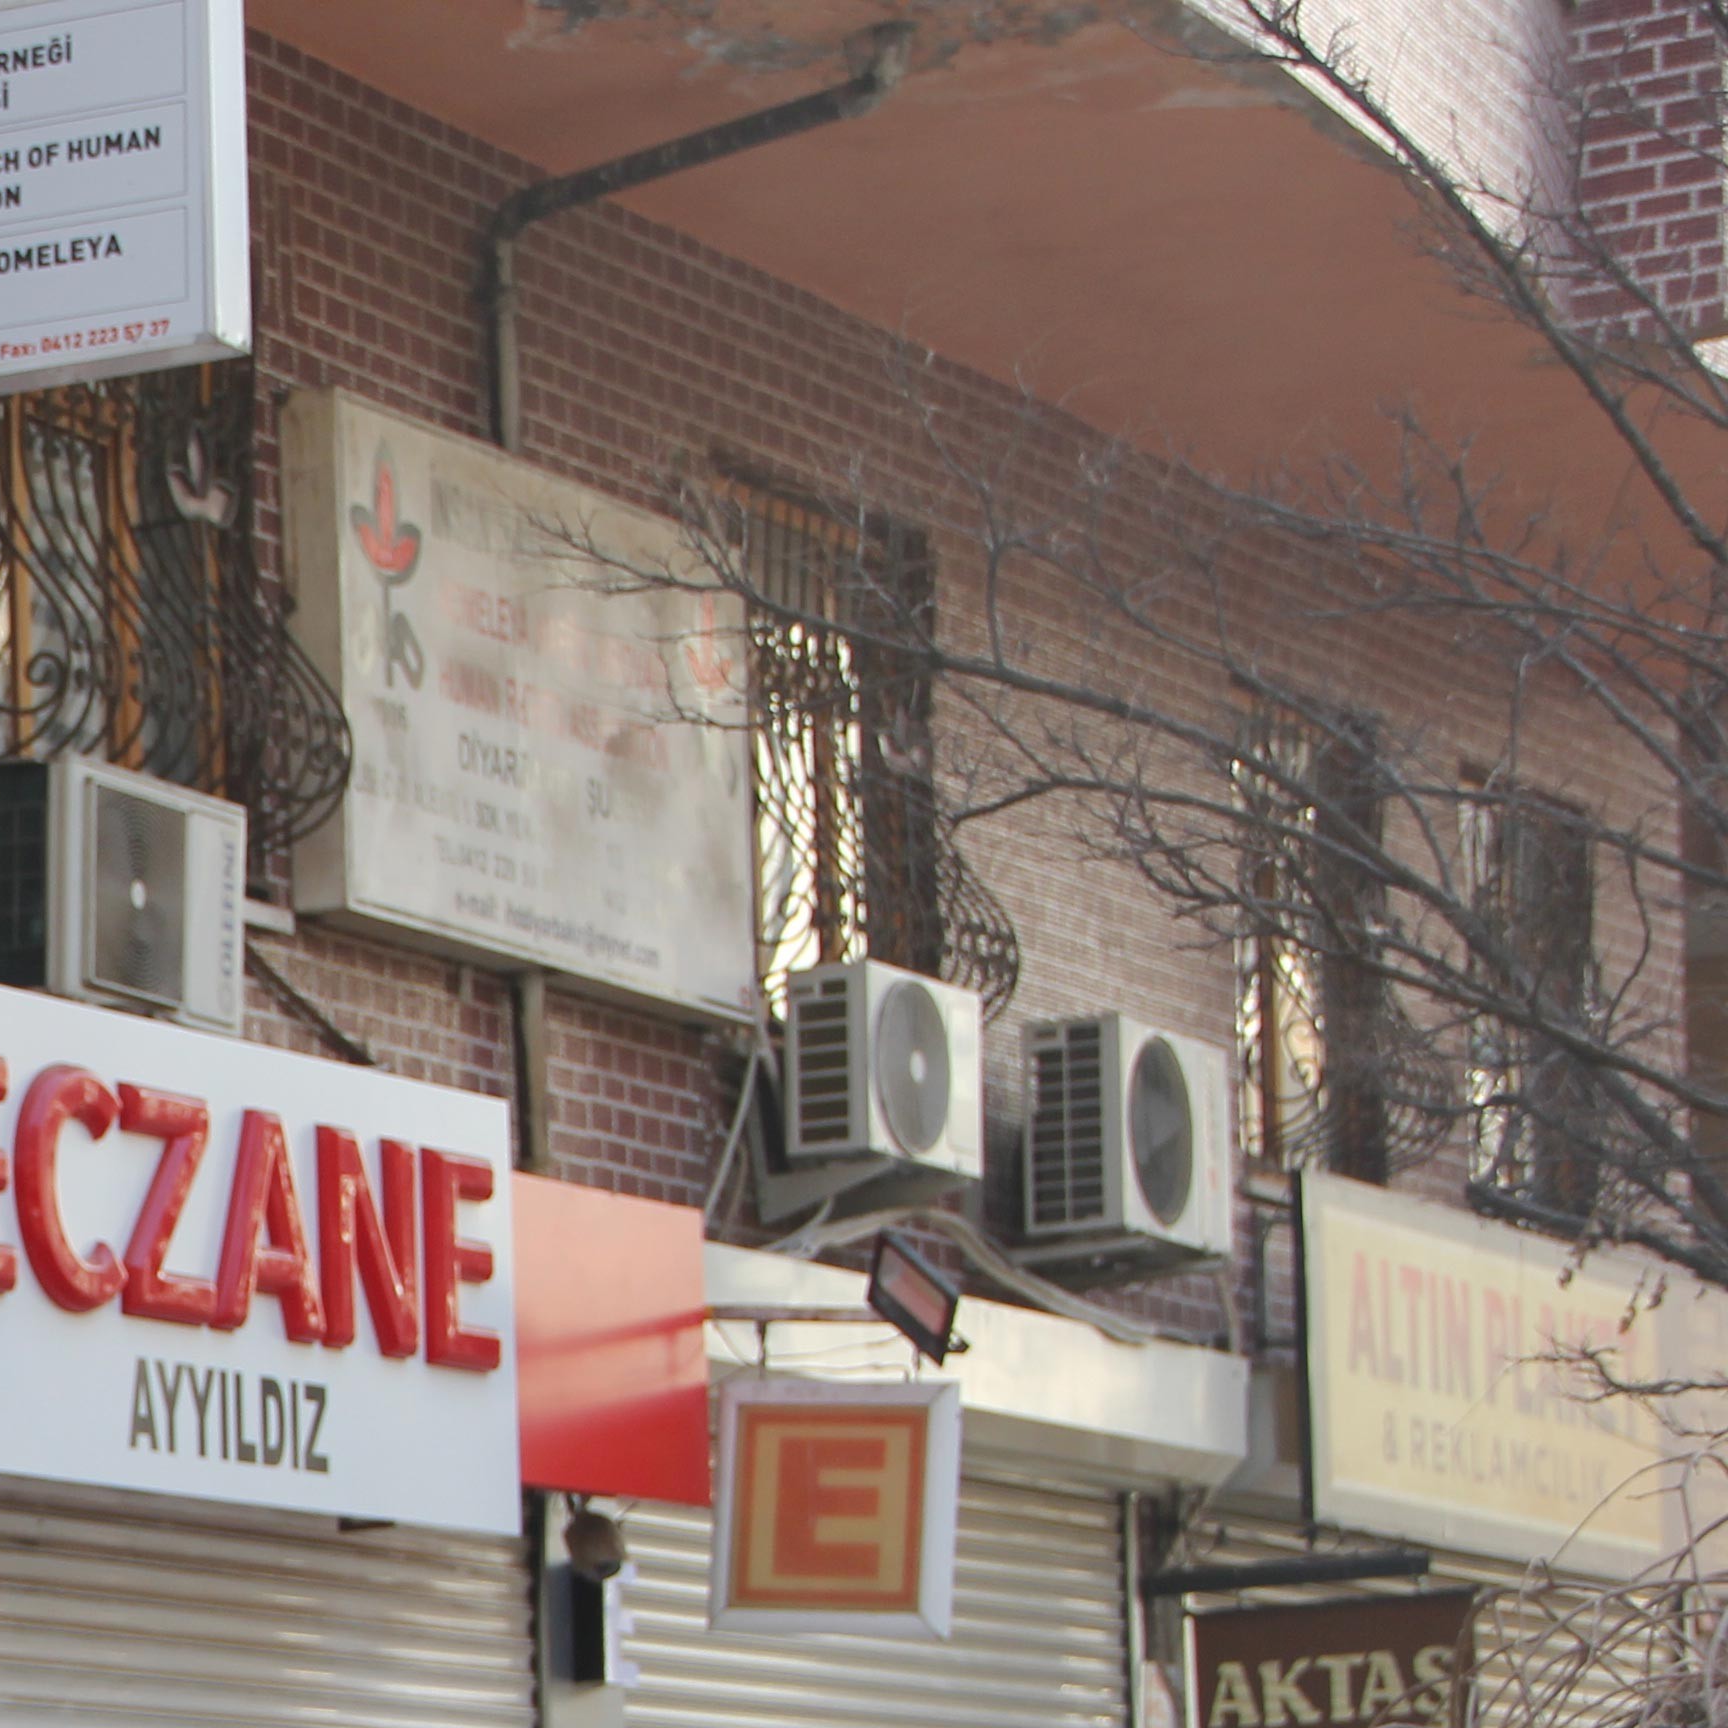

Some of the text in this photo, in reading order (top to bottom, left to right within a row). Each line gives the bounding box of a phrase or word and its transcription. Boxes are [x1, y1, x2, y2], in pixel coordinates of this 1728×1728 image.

[28, 141, 59, 170] OF
[68, 126, 162, 164] HUMAN
[41, 332, 82, 353] 0412
[87, 325, 119, 346] 223
[149, 319, 171, 337] 37
[1348, 1250, 1474, 1402] ALTIN
[128, 1357, 330, 1474] AYYILDIZ
[770, 1435, 888, 1581] E
